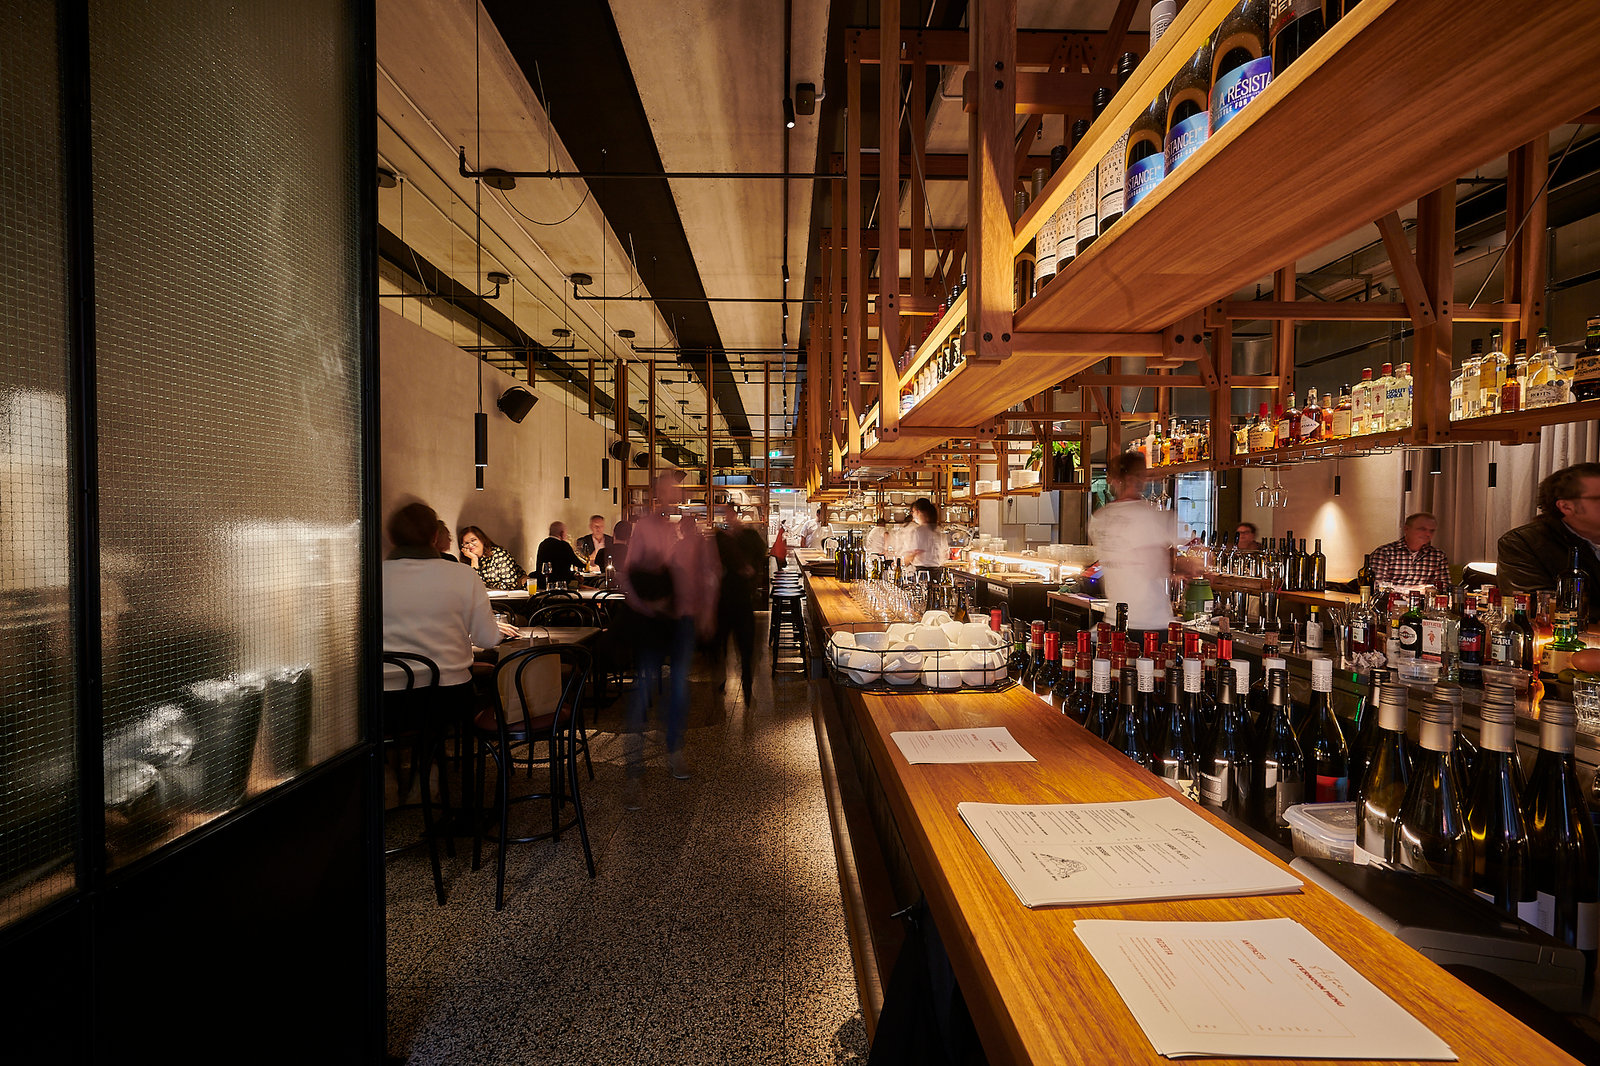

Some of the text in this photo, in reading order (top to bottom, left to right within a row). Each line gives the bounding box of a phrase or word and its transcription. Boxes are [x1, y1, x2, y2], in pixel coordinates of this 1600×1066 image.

[1234, 98, 1248, 110] FOR
[1154, 937, 1174, 956] PIZZETTA
[1240, 938, 1267, 961] ANTIPASTO
[1288, 957, 1325, 991] AFTERNOON
[1324, 990, 1345, 1008] MENU
